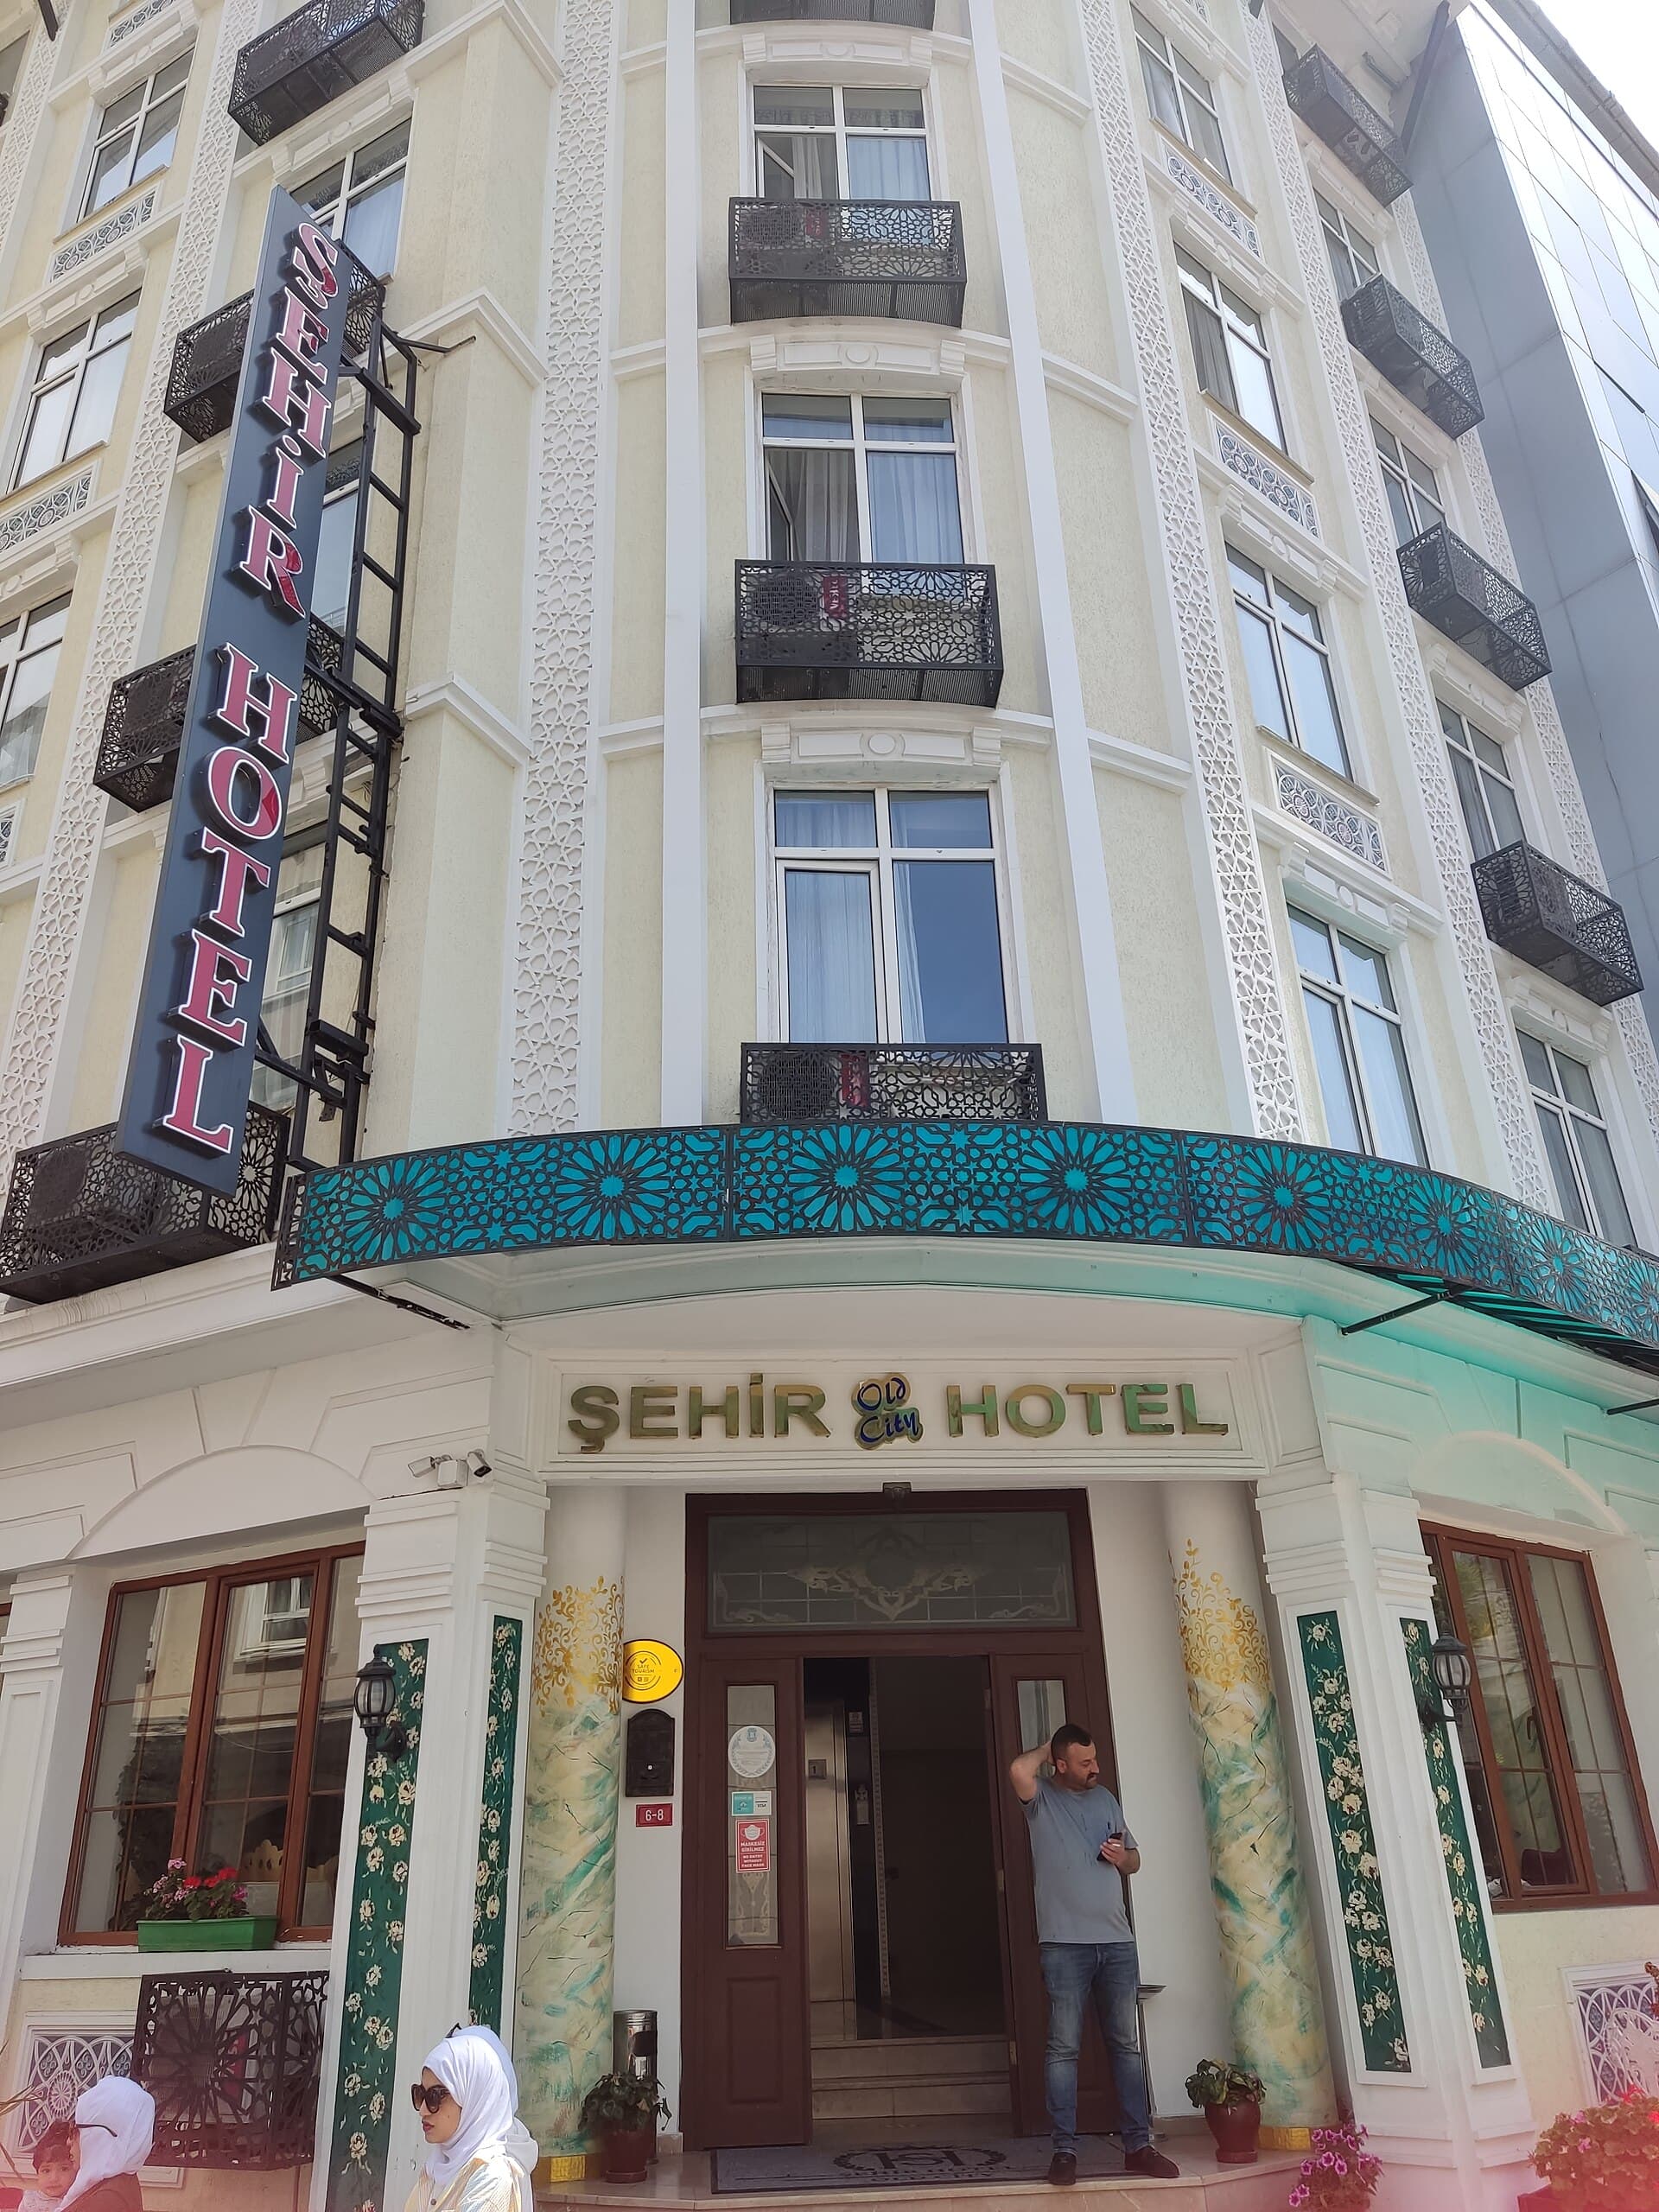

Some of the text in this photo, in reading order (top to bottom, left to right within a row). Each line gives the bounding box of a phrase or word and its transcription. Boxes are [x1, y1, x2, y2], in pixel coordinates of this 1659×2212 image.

[162, 642, 298, 1154] HOTEL
[567, 1372, 831, 1454] ŞEHİR
[946, 1382, 1229, 1438] HOTEL
[645, 1808, 664, 1821] 6-8
